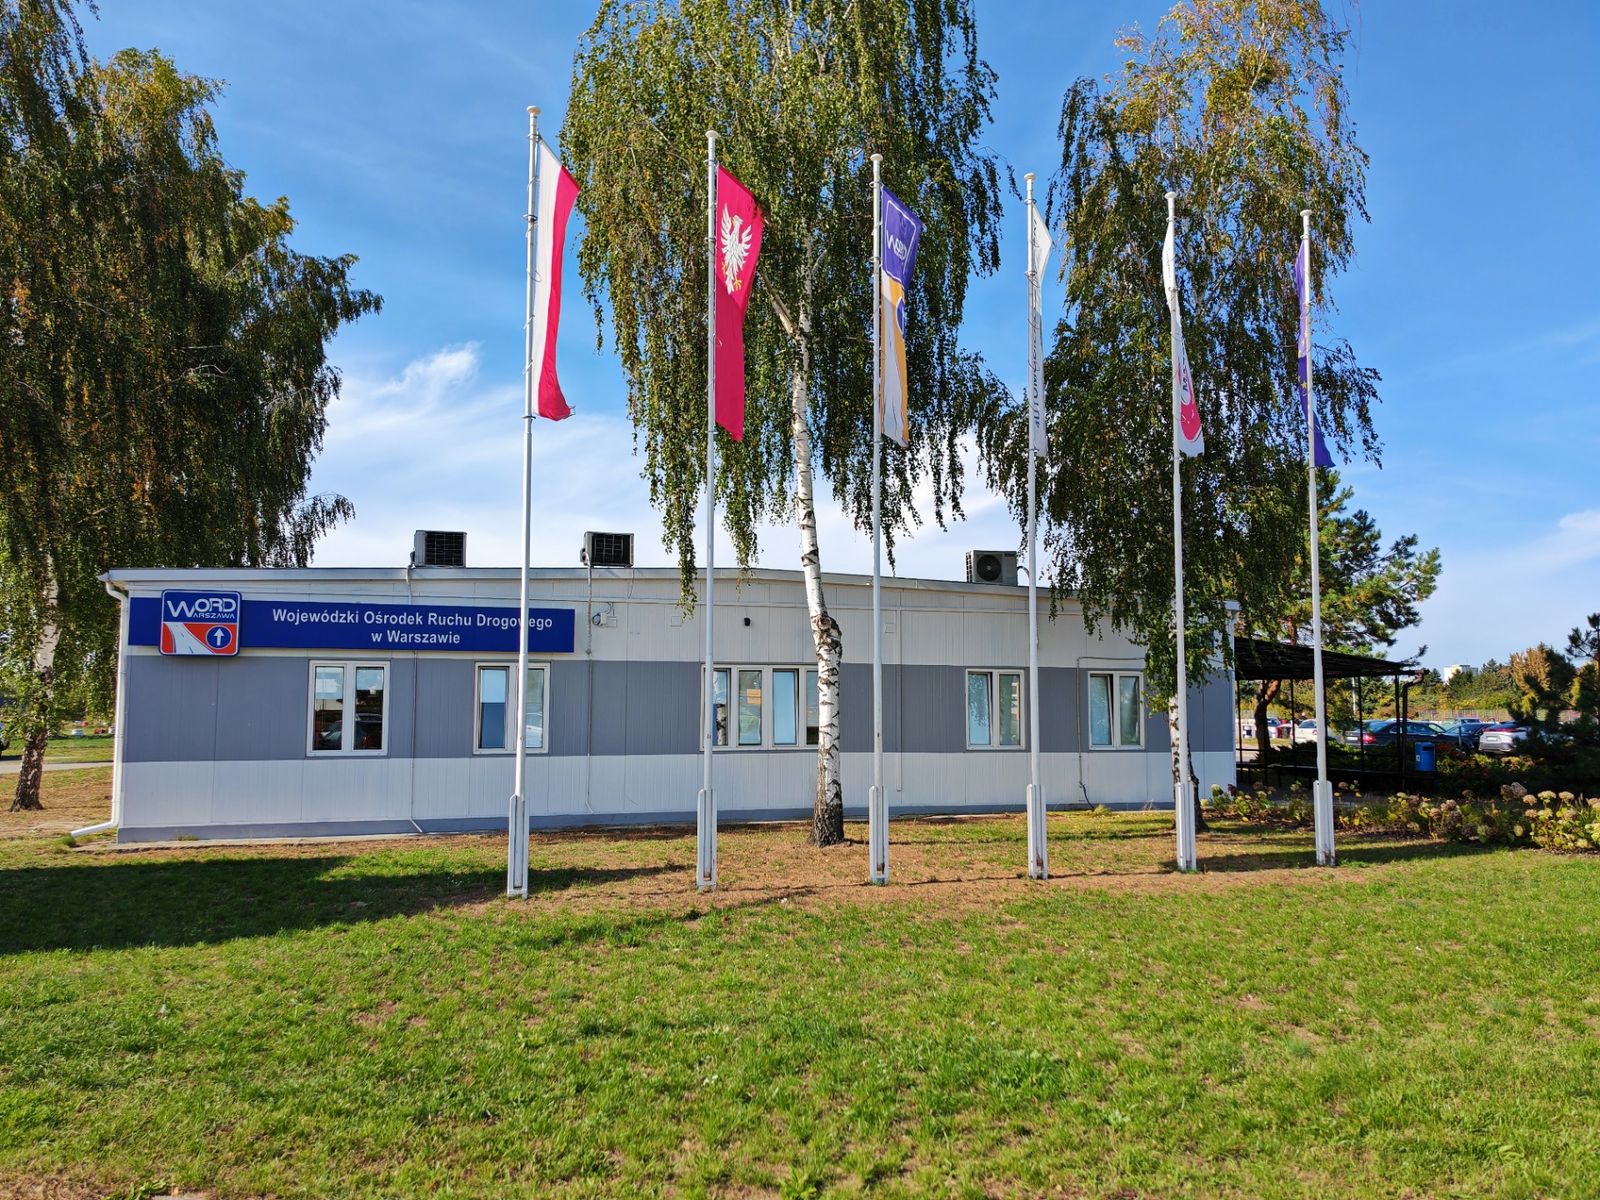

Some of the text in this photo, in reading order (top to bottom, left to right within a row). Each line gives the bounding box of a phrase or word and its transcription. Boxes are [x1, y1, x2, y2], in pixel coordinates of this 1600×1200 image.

[166, 598, 236, 617] WORD
[272, 608, 553, 630] Wojewódzki Ośrodek Ruchu Drogoego
[371, 629, 461, 644] w Warszawie
